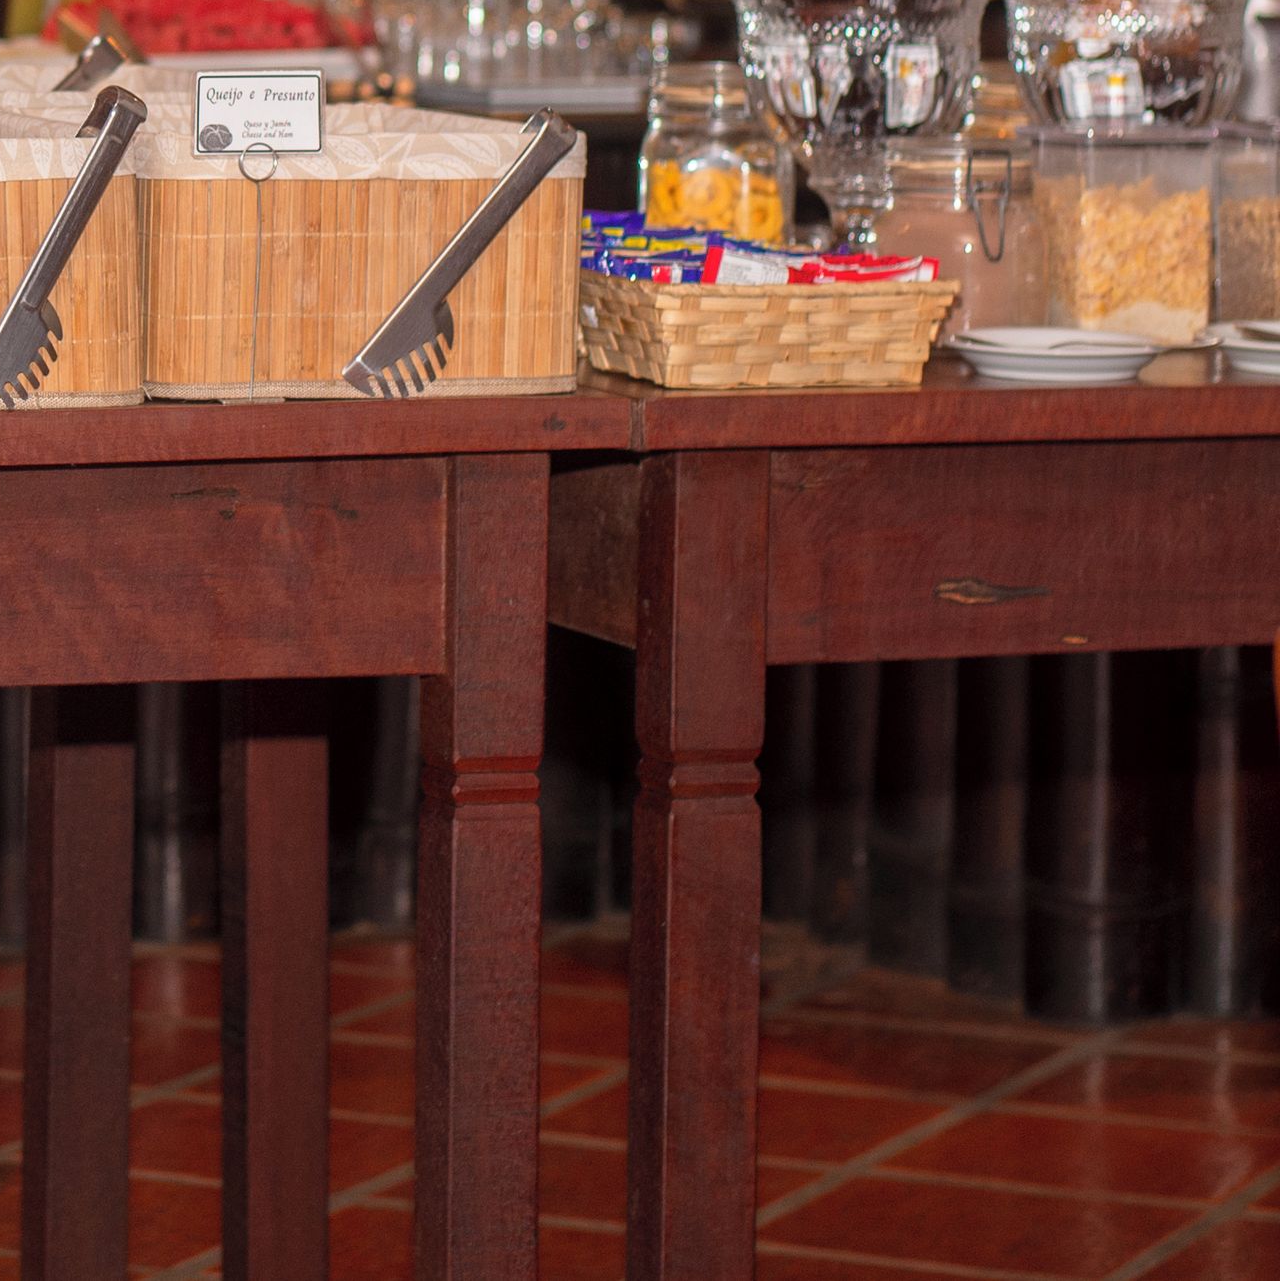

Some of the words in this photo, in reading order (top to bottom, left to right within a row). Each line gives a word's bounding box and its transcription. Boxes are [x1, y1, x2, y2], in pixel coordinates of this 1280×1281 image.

[206, 88, 243, 106] Queijo
[249, 90, 256, 100] e
[263, 88, 316, 101] Presunto
[264, 130, 277, 138] and
